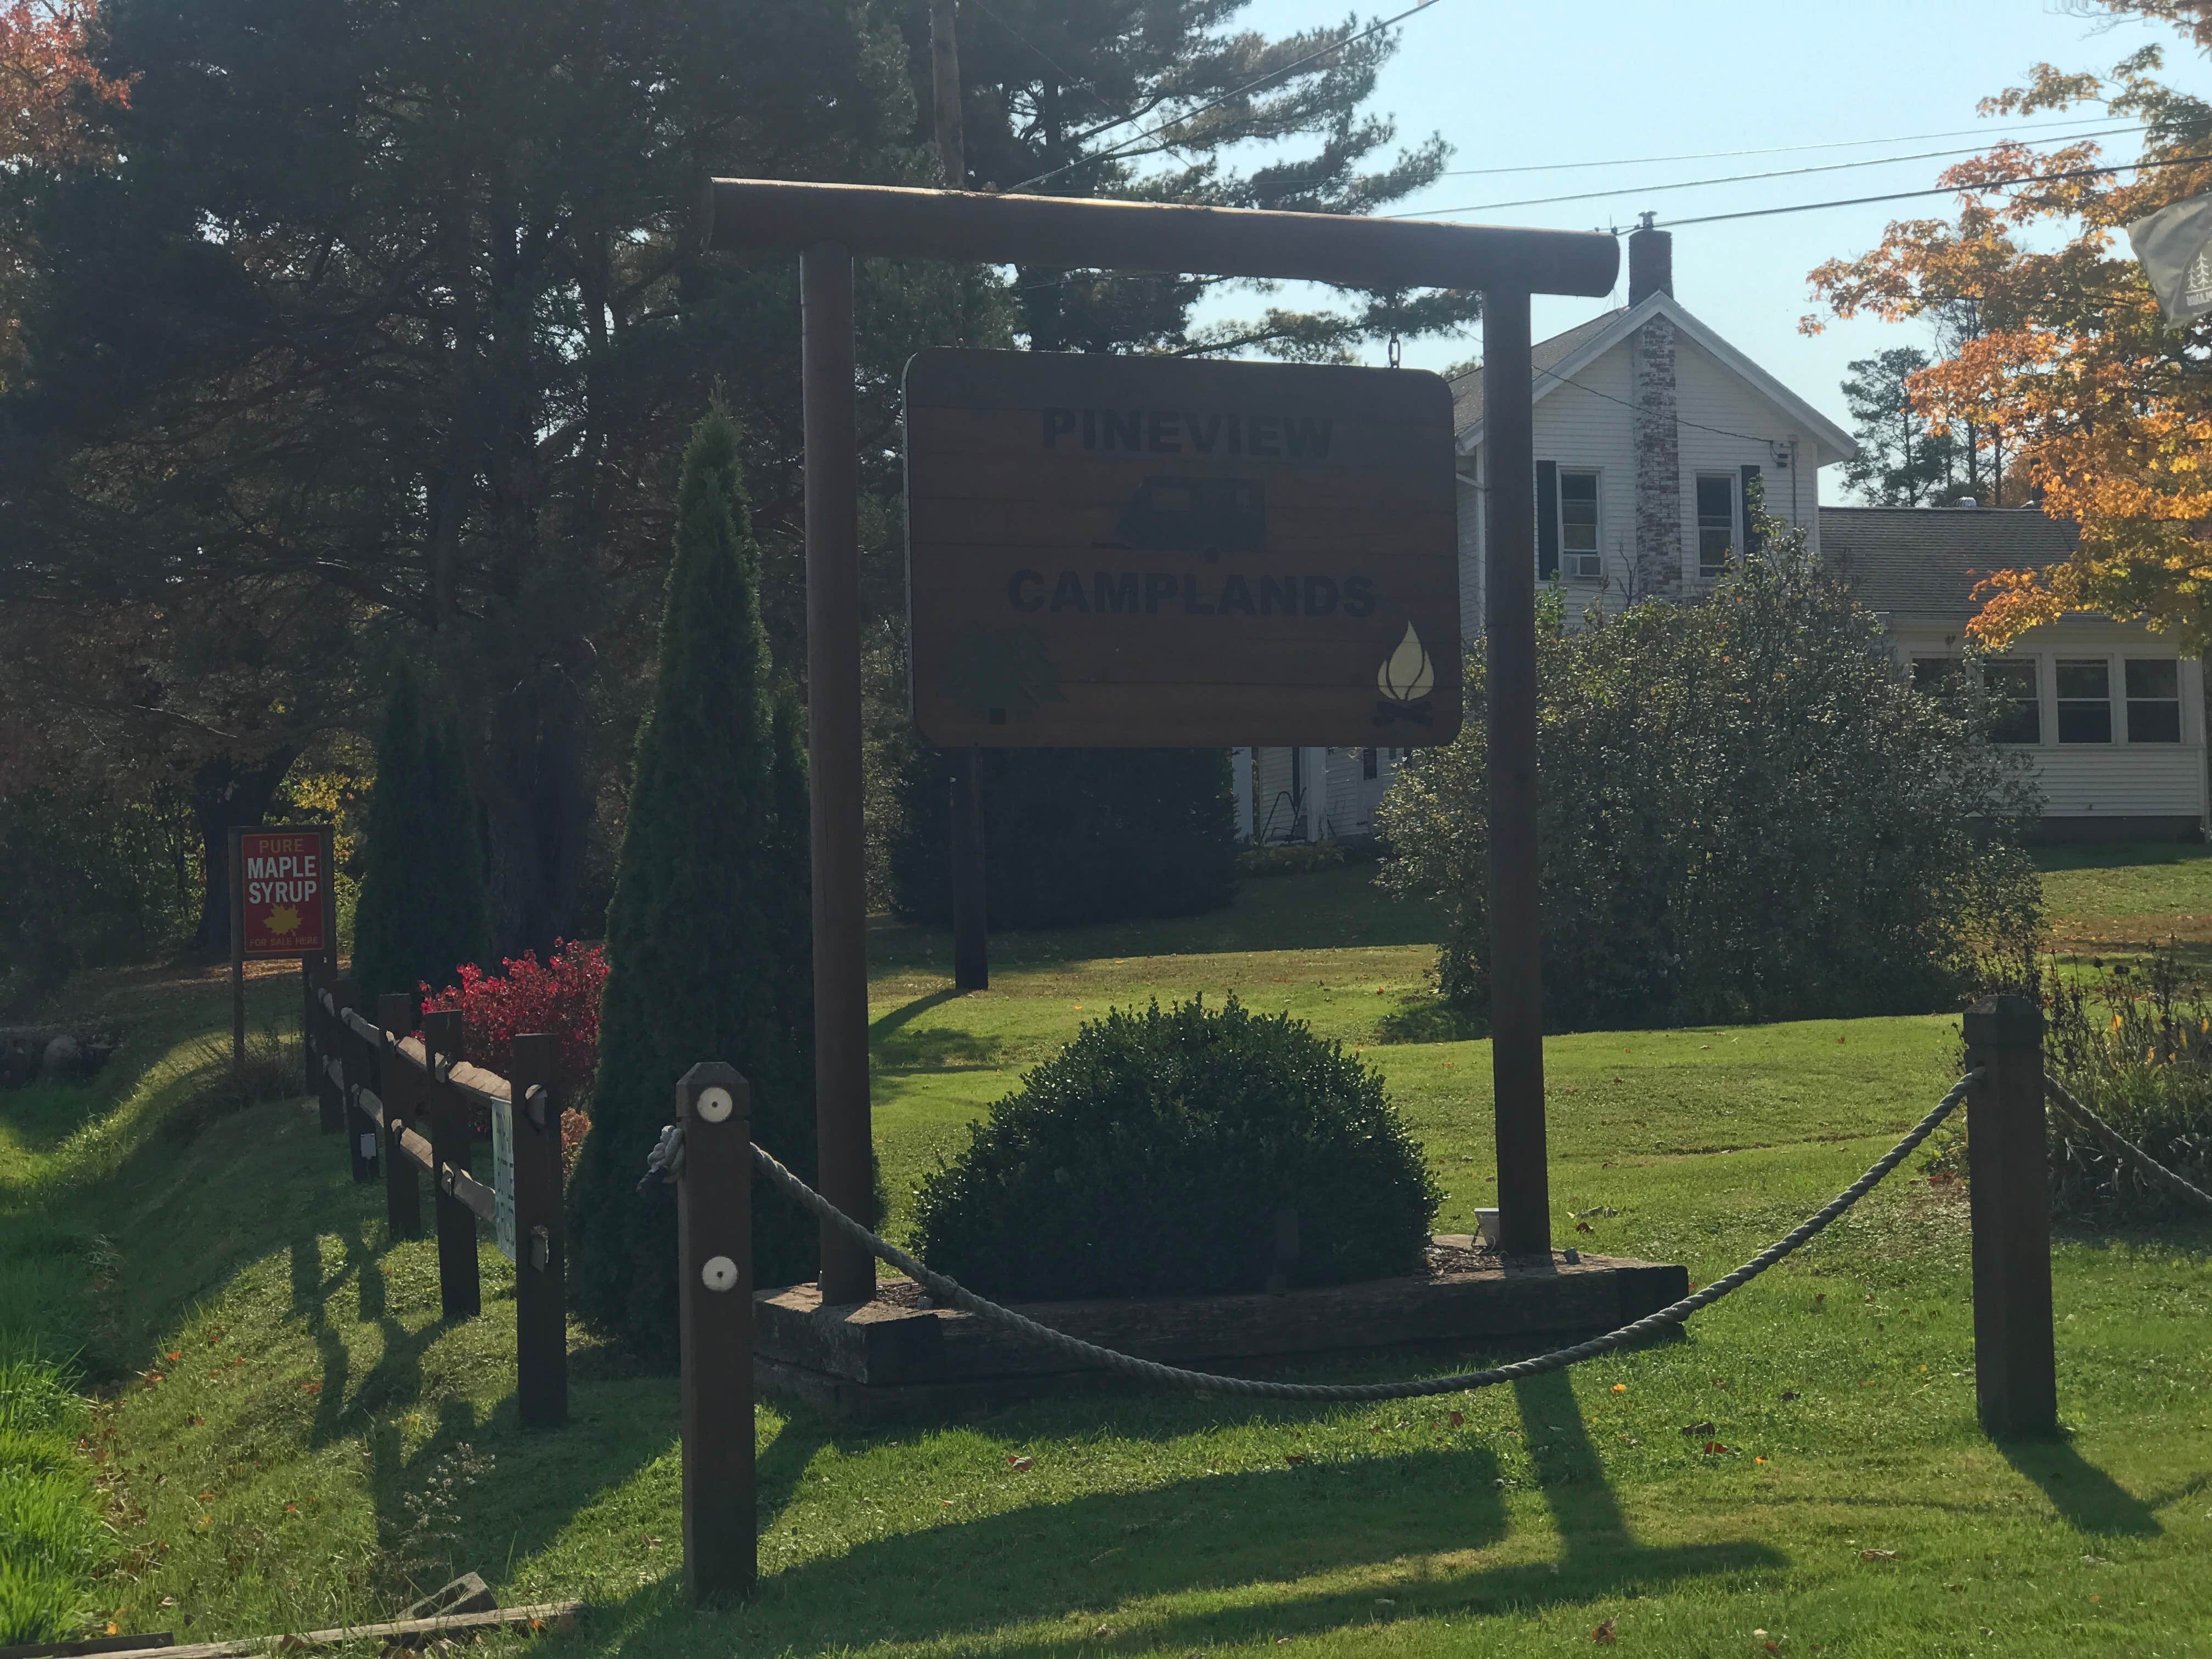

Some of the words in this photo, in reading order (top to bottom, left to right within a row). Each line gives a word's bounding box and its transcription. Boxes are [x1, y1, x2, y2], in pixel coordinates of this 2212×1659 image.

[1041, 407, 1333, 459] PINEVIEW
[1008, 569, 1377, 618] CAMPLANDS
[259, 838, 304, 854] PURE
[247, 855, 317, 879] MAPLE
[249, 880, 317, 904] SYRUP
[250, 939, 267, 947] FOR
[271, 938, 291, 946] SALE
[295, 936, 318, 945] HERE
